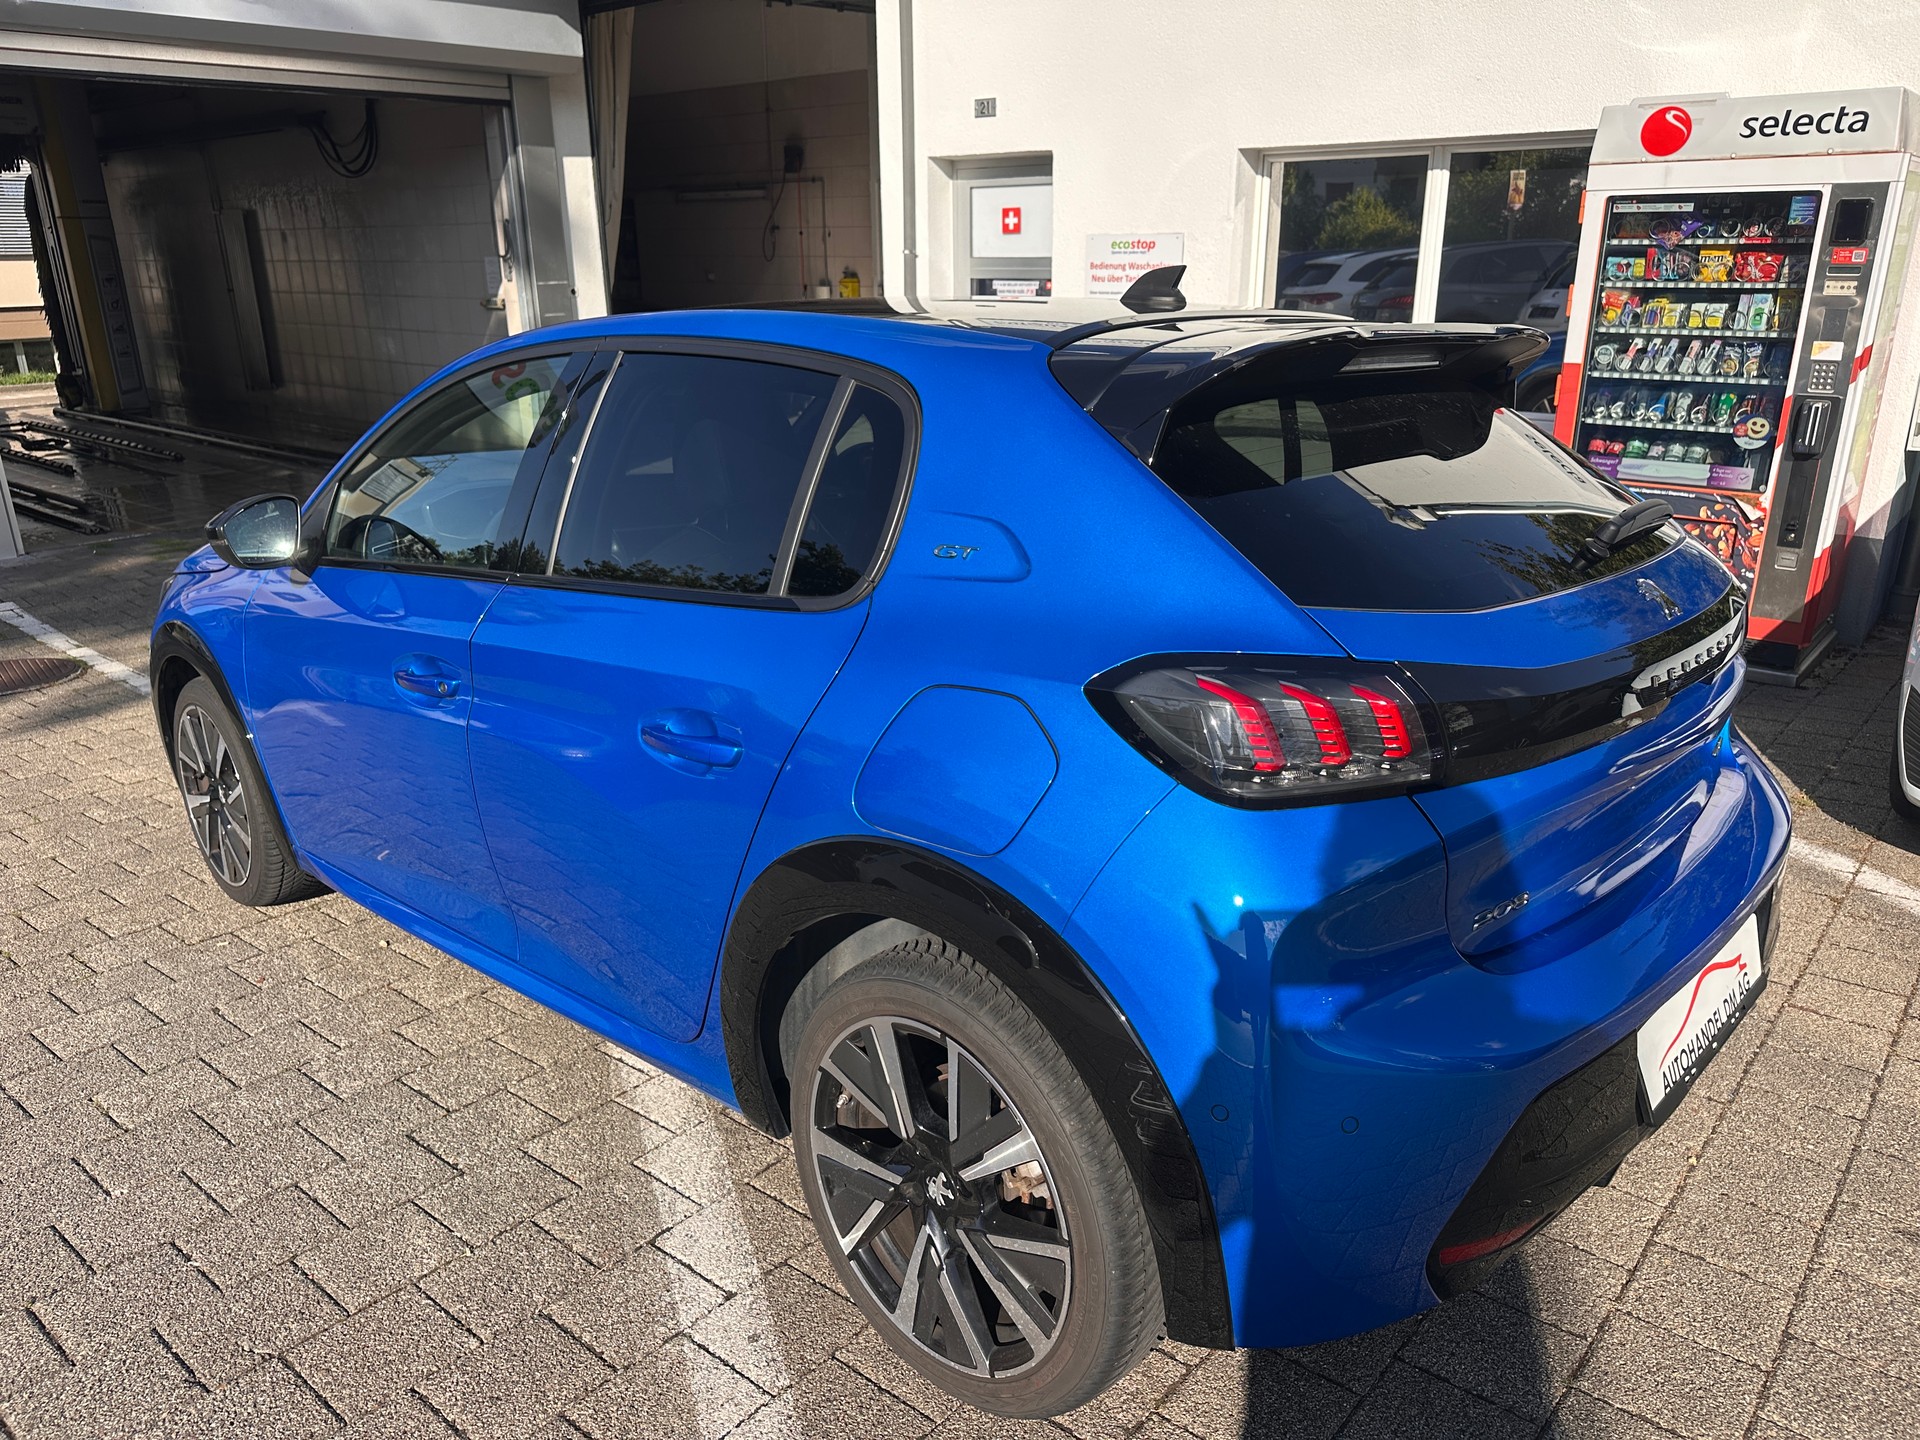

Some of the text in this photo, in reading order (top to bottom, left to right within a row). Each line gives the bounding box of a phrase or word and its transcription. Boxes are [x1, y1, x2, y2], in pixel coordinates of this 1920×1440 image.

[979, 100, 990, 114] 21
[1739, 106, 1870, 139] selecta
[1111, 239, 1156, 252] ecostop
[1090, 261, 1127, 272] Bedienung
[1091, 274, 1106, 283] Neu
[1107, 274, 1123, 283] über
[933, 543, 981, 560] GT
[1650, 633, 1733, 688] PEUGEOT
[1661, 971, 1751, 1096] AUTOHANDEL DM AG
